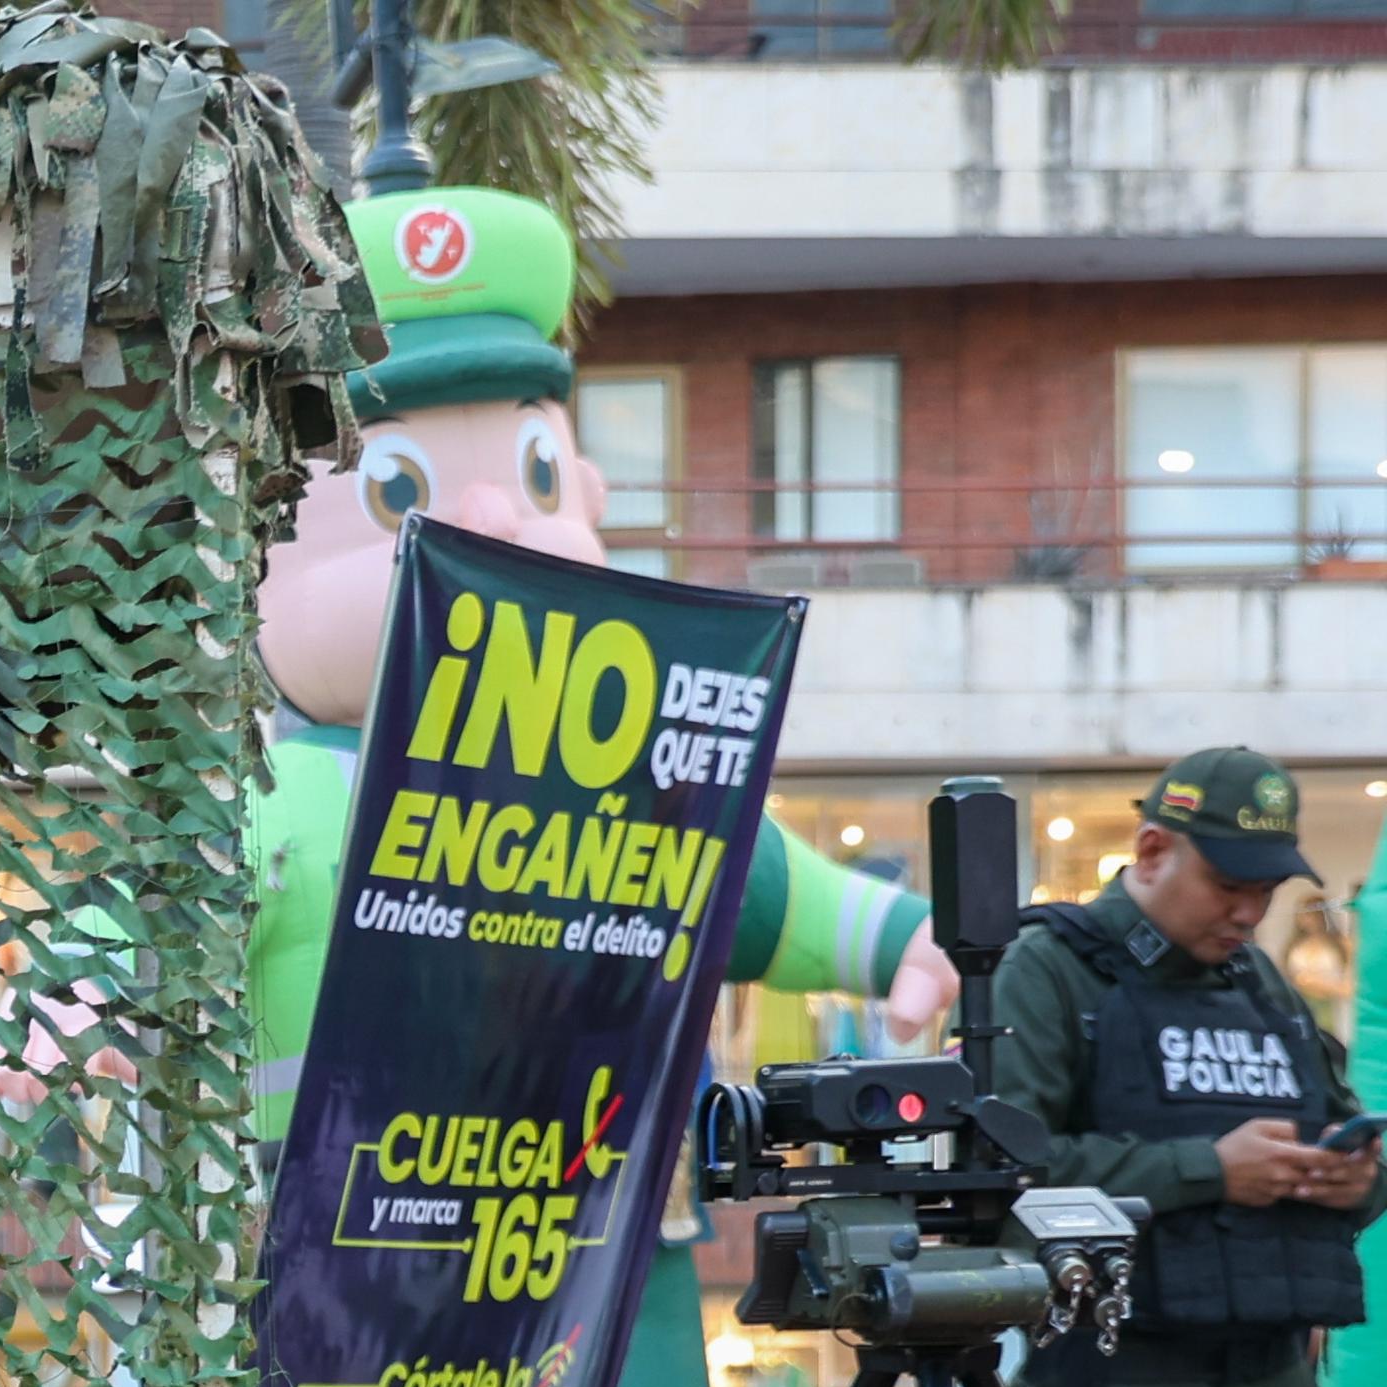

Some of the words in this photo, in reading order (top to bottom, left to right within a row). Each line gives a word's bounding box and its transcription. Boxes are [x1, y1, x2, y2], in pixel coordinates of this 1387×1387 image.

[406, 592, 658, 789] ¡NO
[660, 663, 771, 732] DEJES
[650, 727, 716, 790] QUE
[715, 737, 754, 787] TE
[369, 788, 725, 982] ENGAÑEN!
[353, 889, 467, 940] Unidos
[468, 908, 561, 949] contra
[563, 913, 591, 952] el
[592, 916, 665, 959] delito
[1158, 1026, 1293, 1065] GAULA
[377, 1111, 564, 1188] CUELGA
[370, 1198, 387, 1230] y
[390, 1197, 463, 1225] marca
[463, 1195, 577, 1302] 165
